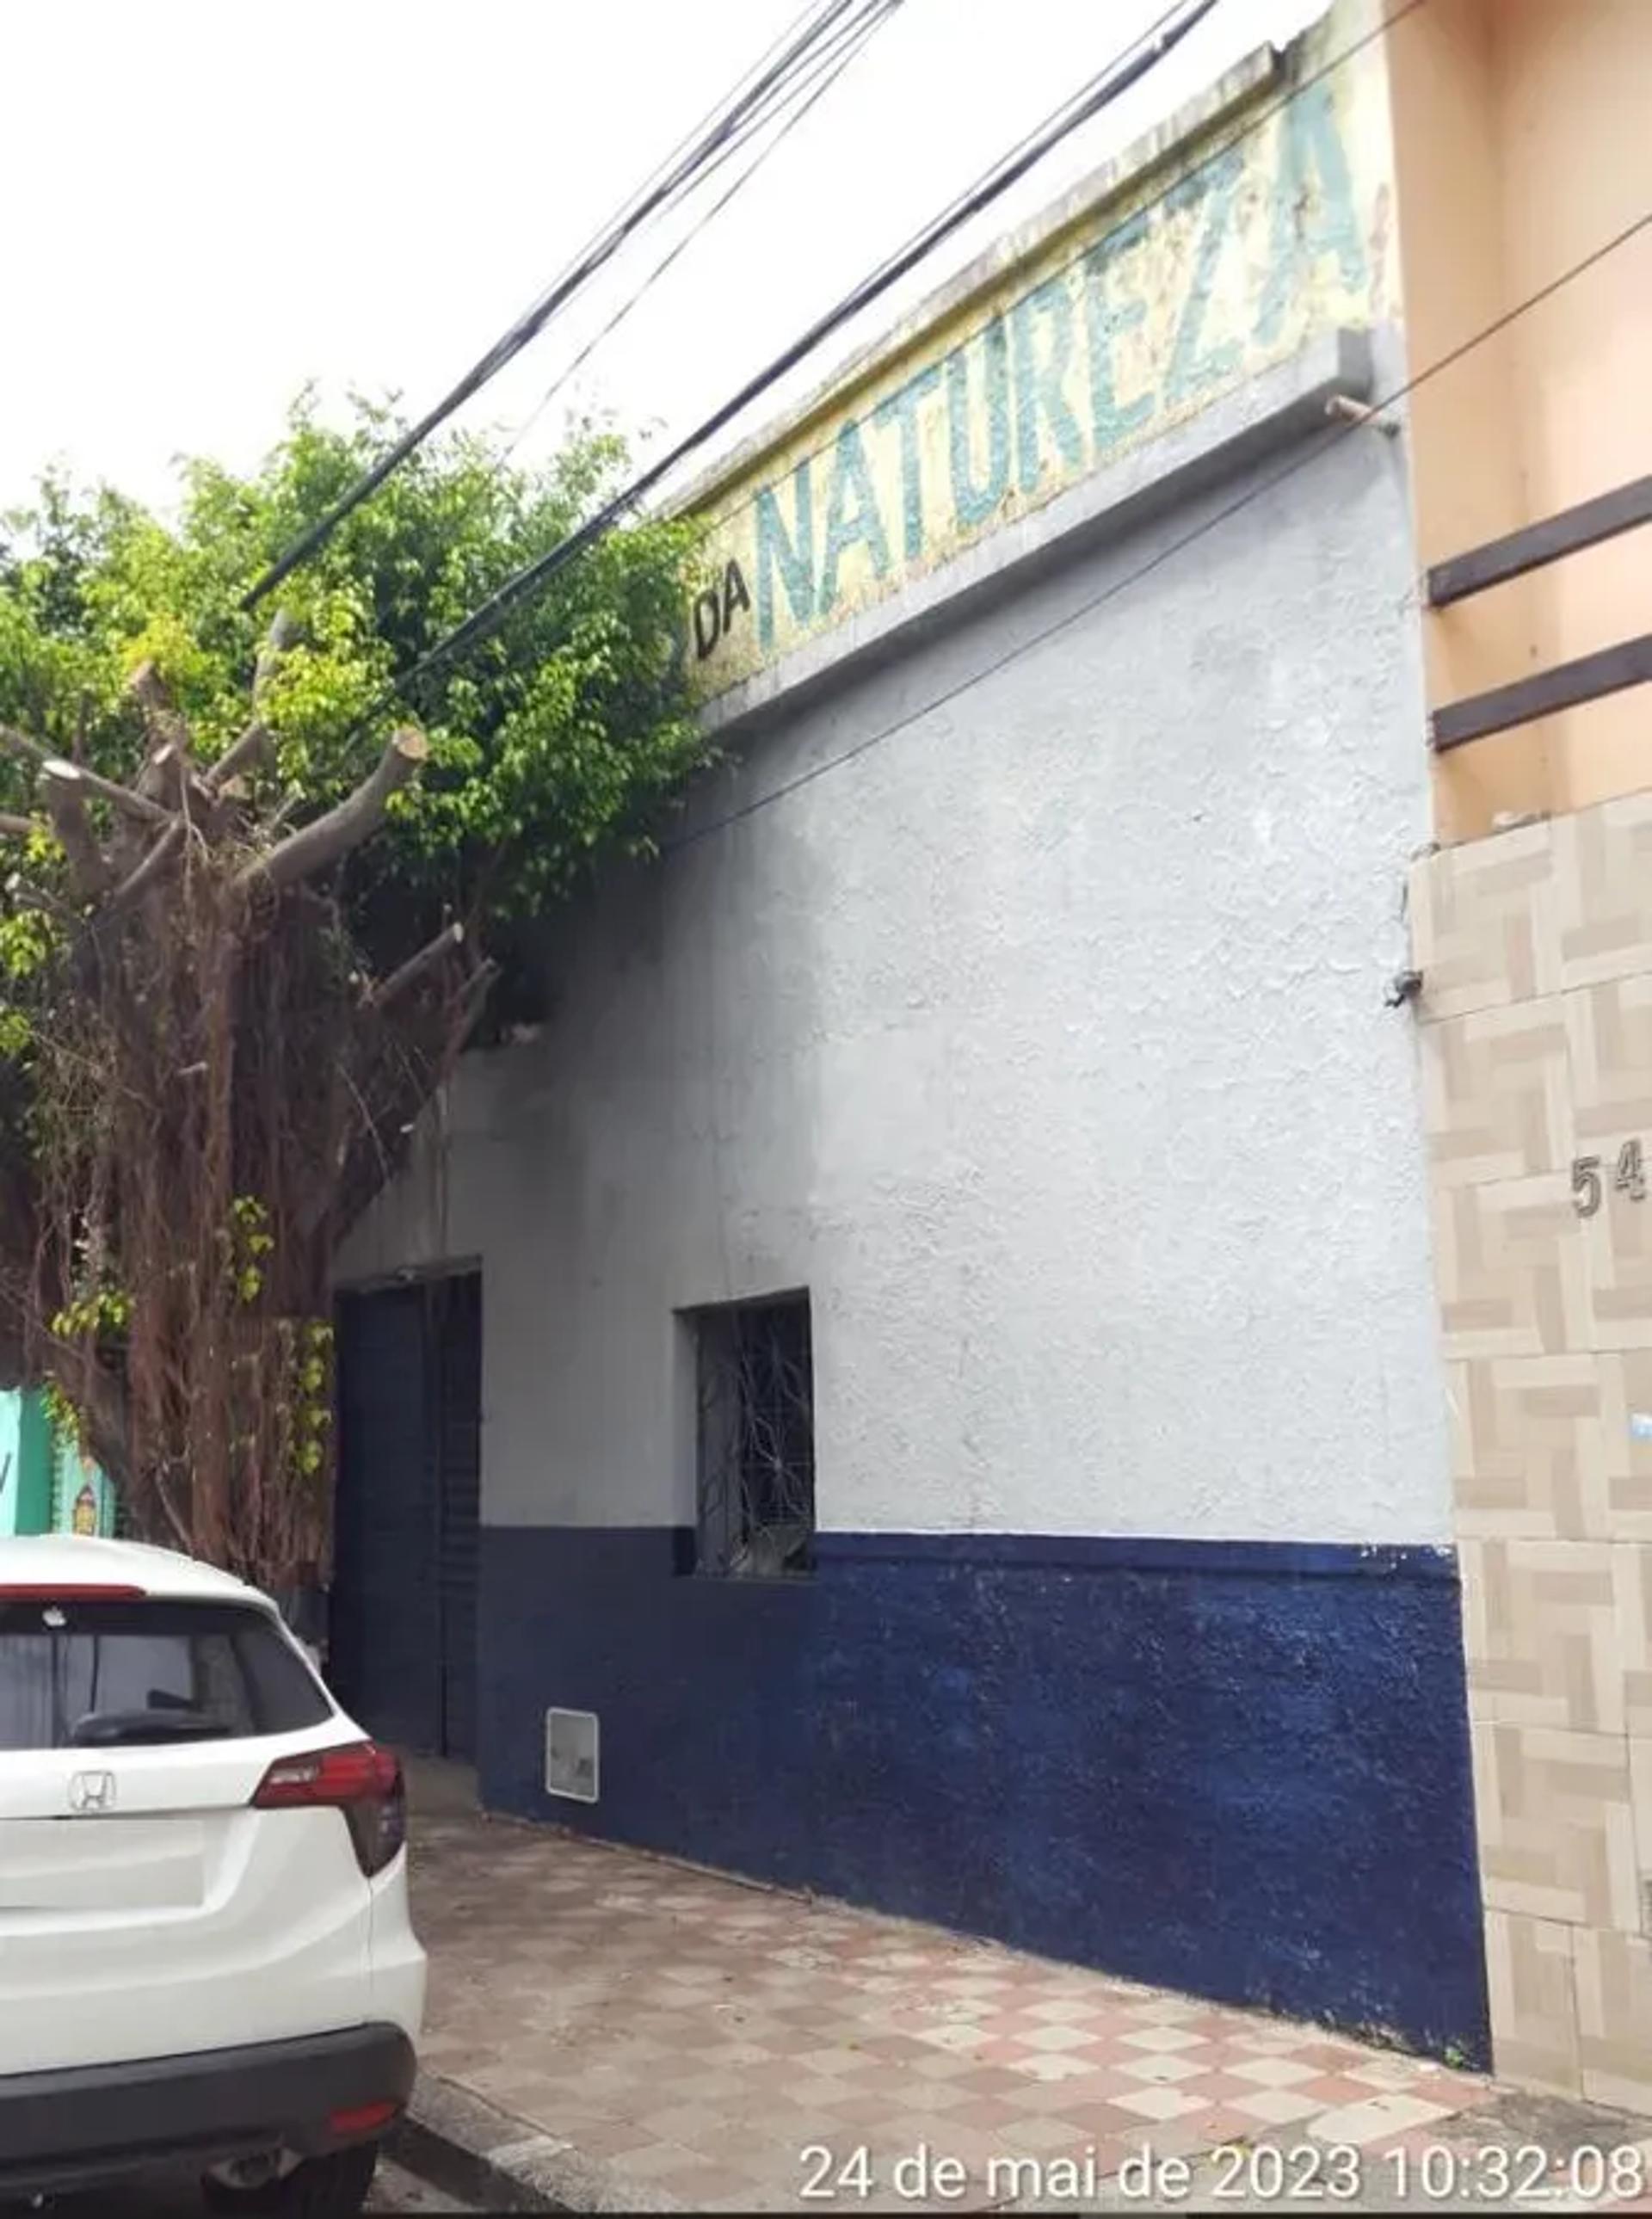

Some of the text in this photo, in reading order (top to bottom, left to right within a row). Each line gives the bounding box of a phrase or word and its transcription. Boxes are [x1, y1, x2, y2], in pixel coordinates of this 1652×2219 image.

[693, 83, 1368, 662] DA NATUREZA
[1571, 1139, 1647, 1218] 54
